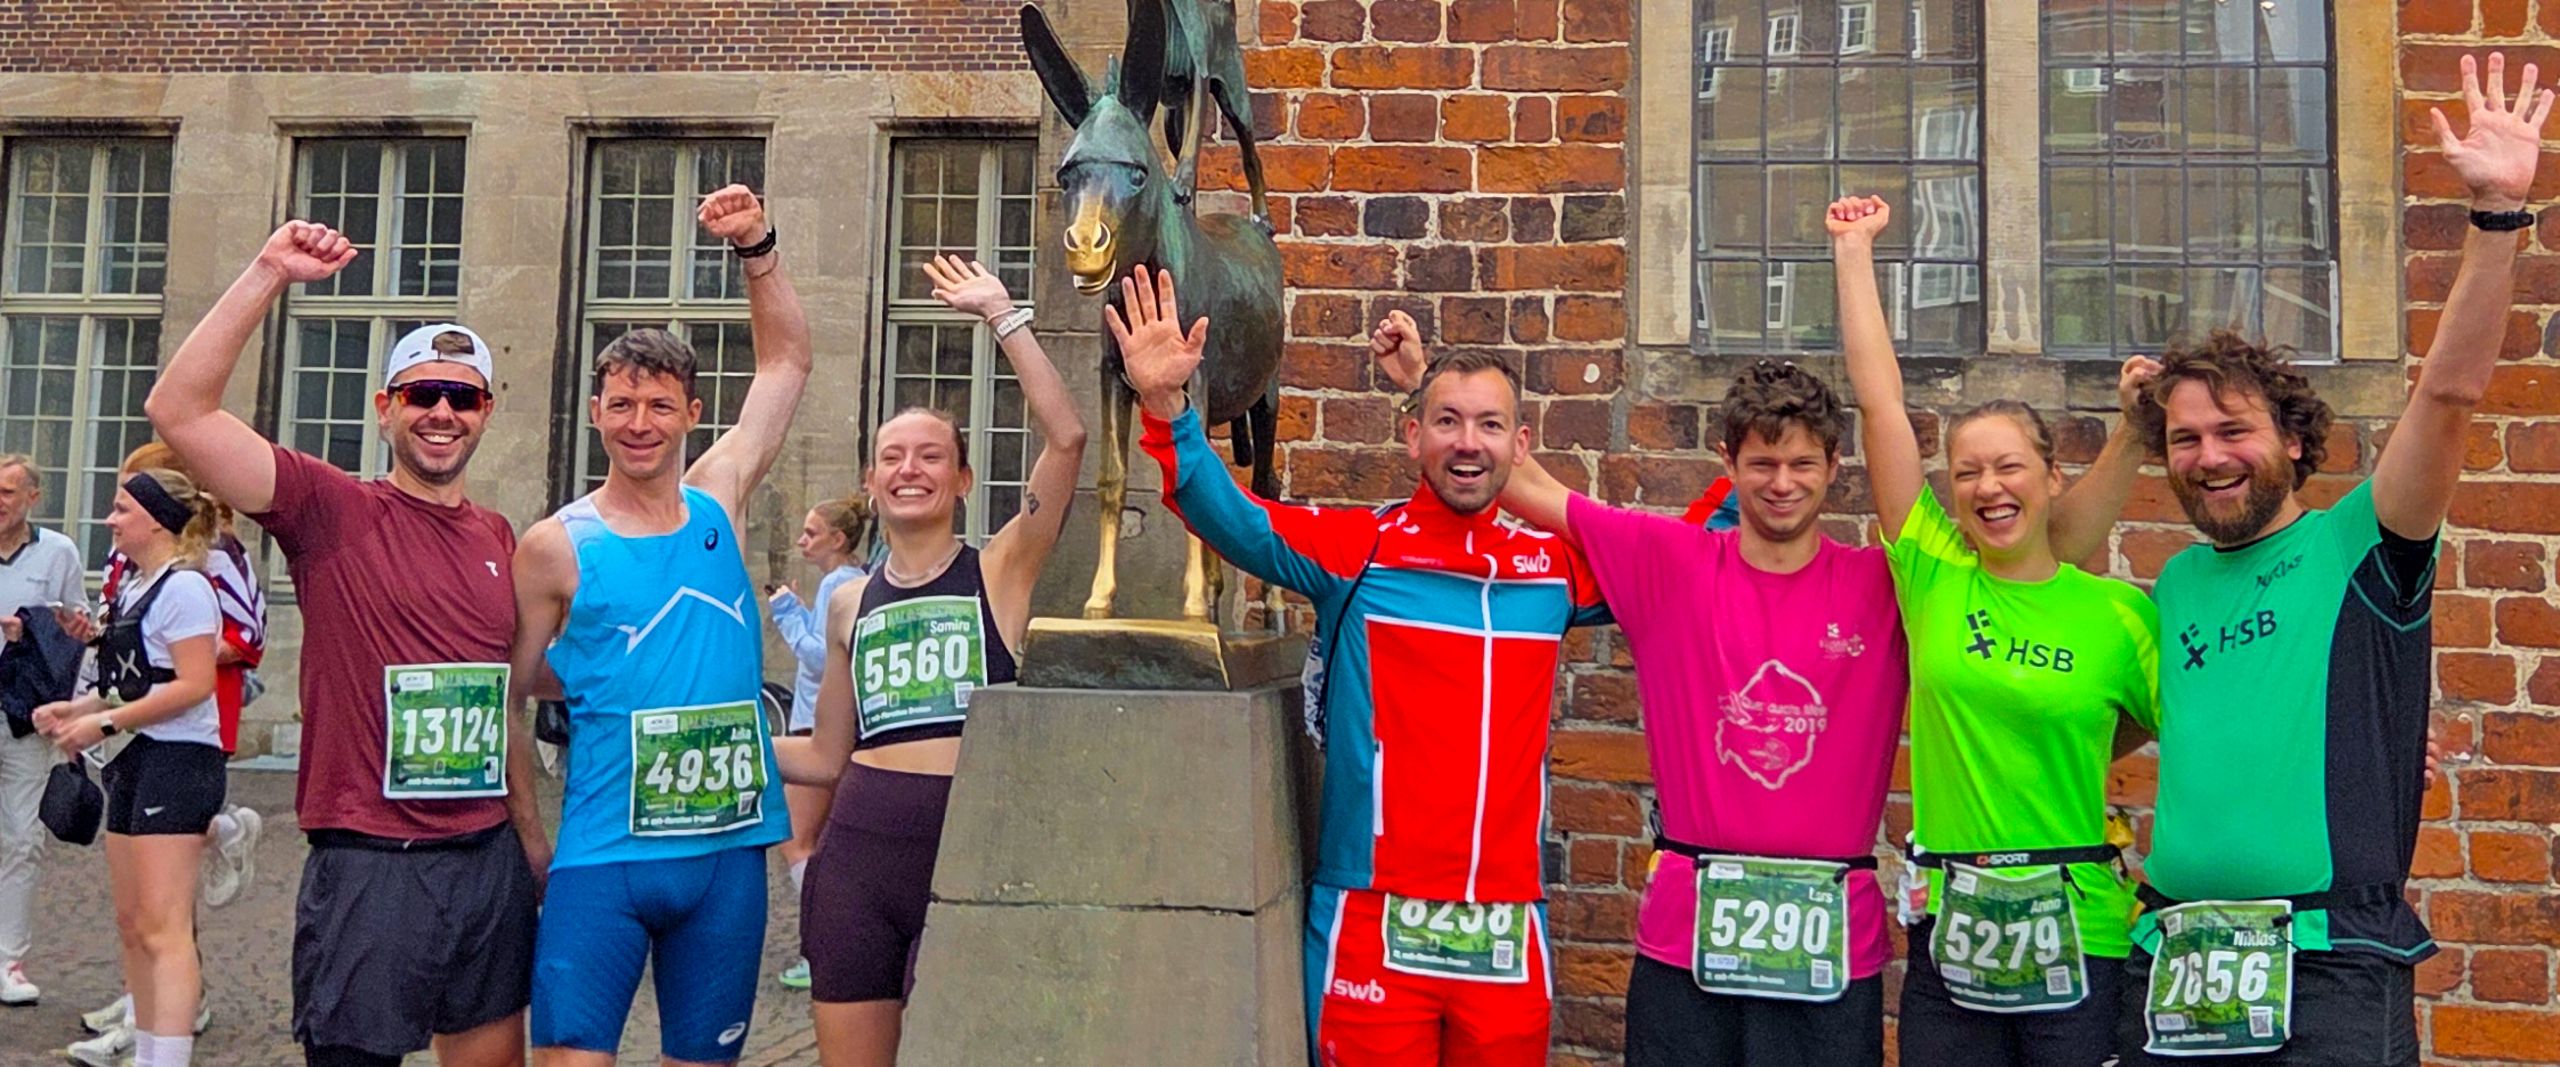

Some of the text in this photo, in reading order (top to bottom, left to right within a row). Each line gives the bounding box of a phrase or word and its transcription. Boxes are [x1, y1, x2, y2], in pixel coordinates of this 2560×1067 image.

[1512, 547, 1551, 573] swb
[2005, 636, 2075, 673] HSB
[2219, 610, 2277, 653] HSB
[864, 634, 969, 693] 5560
[402, 706, 499, 756] 13124
[1784, 717, 1828, 734] 2019
[645, 743, 754, 794] 4936
[1710, 899, 1830, 954] 5290
[1945, 912, 2060, 970] 5279
[2233, 930, 2278, 947] Niklas
[1333, 978, 1386, 1003] swb
[2162, 951, 2271, 1007] 7656
